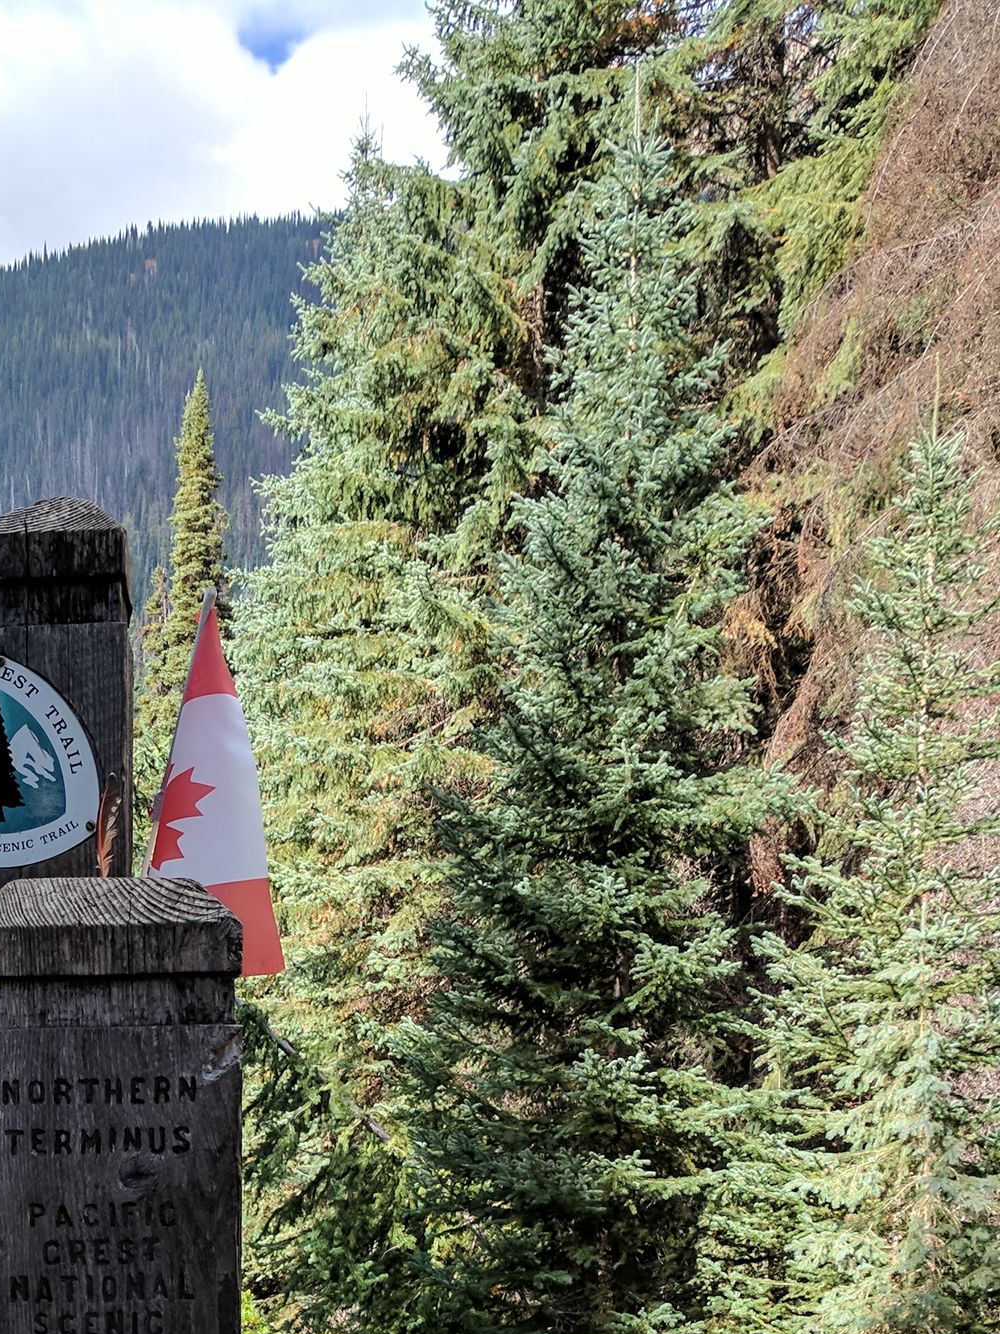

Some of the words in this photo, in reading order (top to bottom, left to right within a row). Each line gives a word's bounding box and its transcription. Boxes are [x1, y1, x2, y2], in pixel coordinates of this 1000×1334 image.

[45, 704, 84, 774] TRAIL
[40, 820, 79, 845] TRAIL
[1, 1075, 198, 1106] NORTHERN
[4, 1125, 192, 1156] TERMINUS
[28, 1201, 178, 1229] PACIFIC
[43, 1236, 161, 1266] CREST
[8, 1271, 196, 1303] NATIONAL
